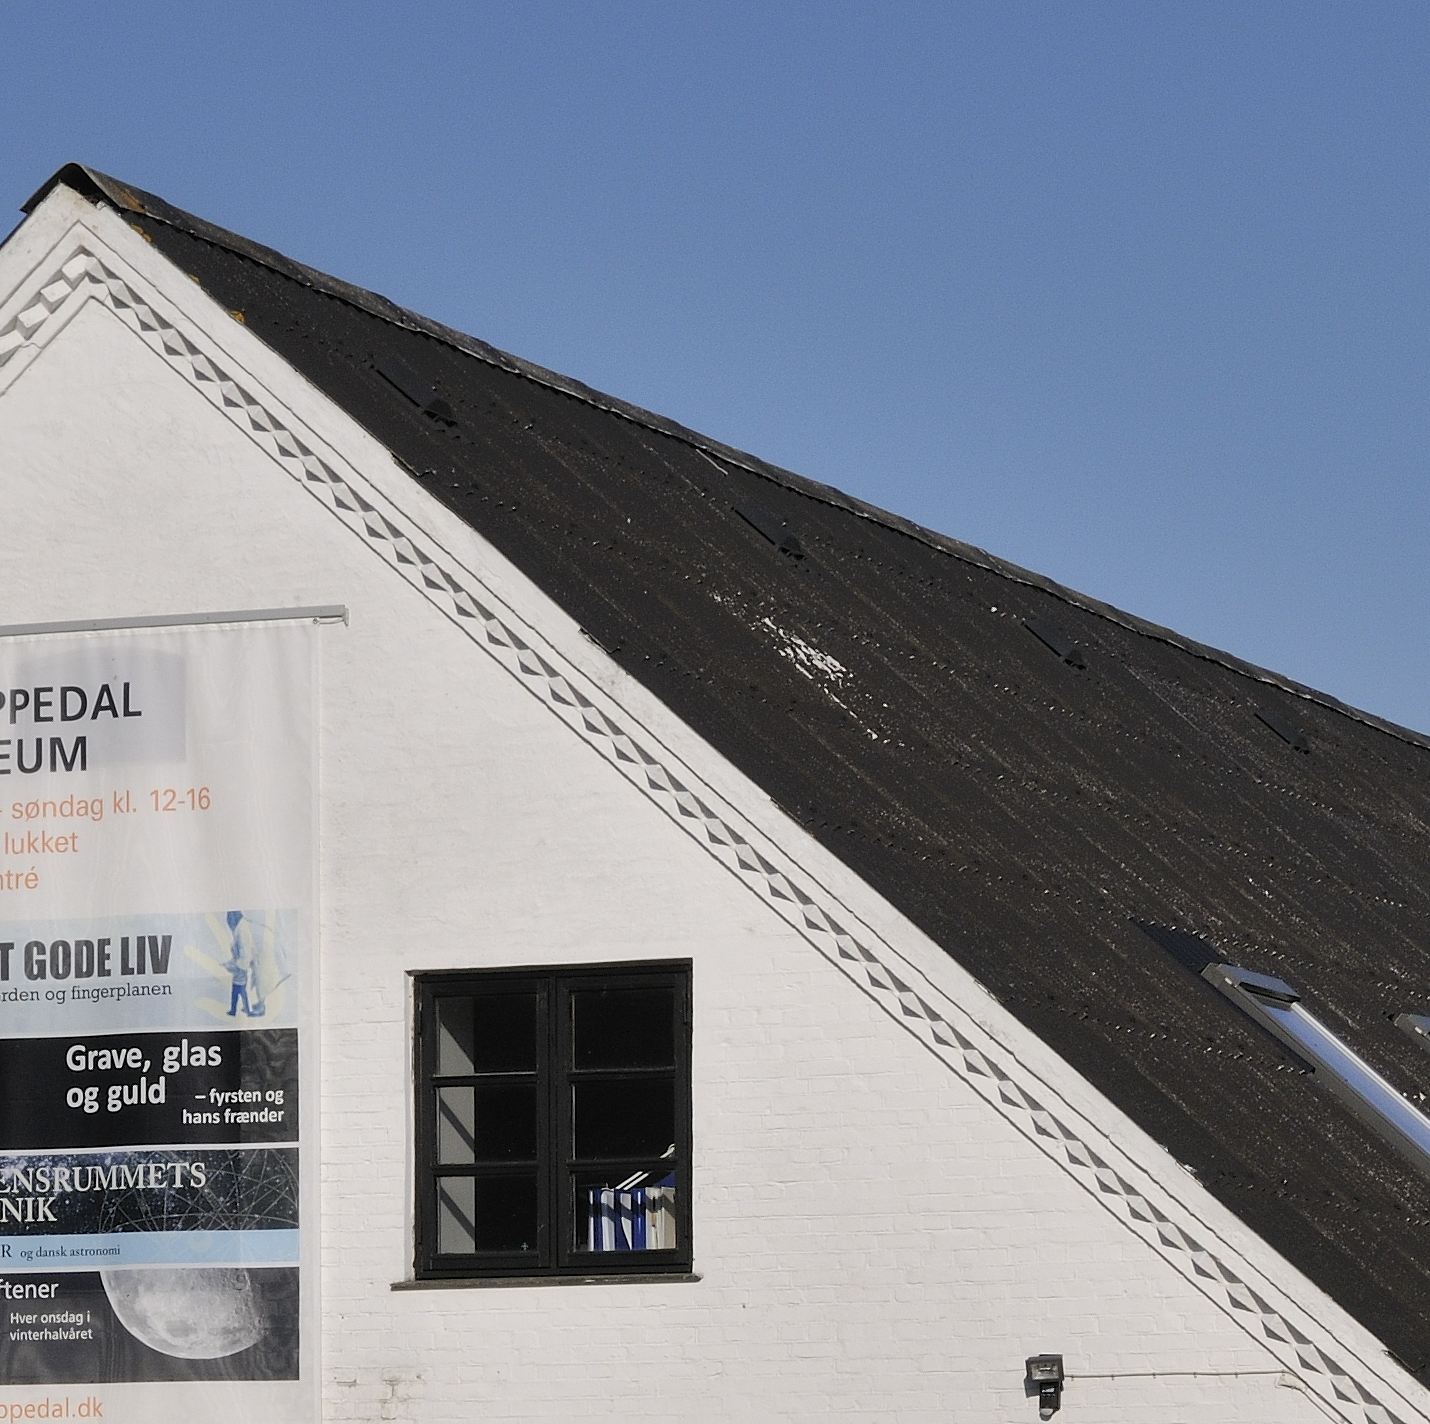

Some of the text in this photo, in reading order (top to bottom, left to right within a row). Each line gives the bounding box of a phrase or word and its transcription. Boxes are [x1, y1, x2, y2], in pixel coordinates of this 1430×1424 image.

[11, 794, 104, 821] søndag
[113, 790, 138, 814] kl.
[150, 787, 211, 812] 12-16
[4, 830, 79, 854] lukket
[24, 936, 111, 981] GODE
[120, 934, 173, 977] LIV
[45, 989, 66, 1004] og
[71, 982, 172, 1001] fingerplanen
[66, 1038, 222, 1073] Grave, glas
[66, 1076, 166, 1114] og guld
[209, 1088, 262, 1105] fyrsten
[265, 1090, 284, 1105] og
[182, 1107, 284, 1125] hans frænder
[20, 1249, 34, 1261] og
[35, 1246, 67, 1258] dansk
[69, 1244, 121, 1257] astronomi
[10, 1310, 90, 1326] Hver onsdag i
[10, 1326, 93, 1342] vinterhalvåret
